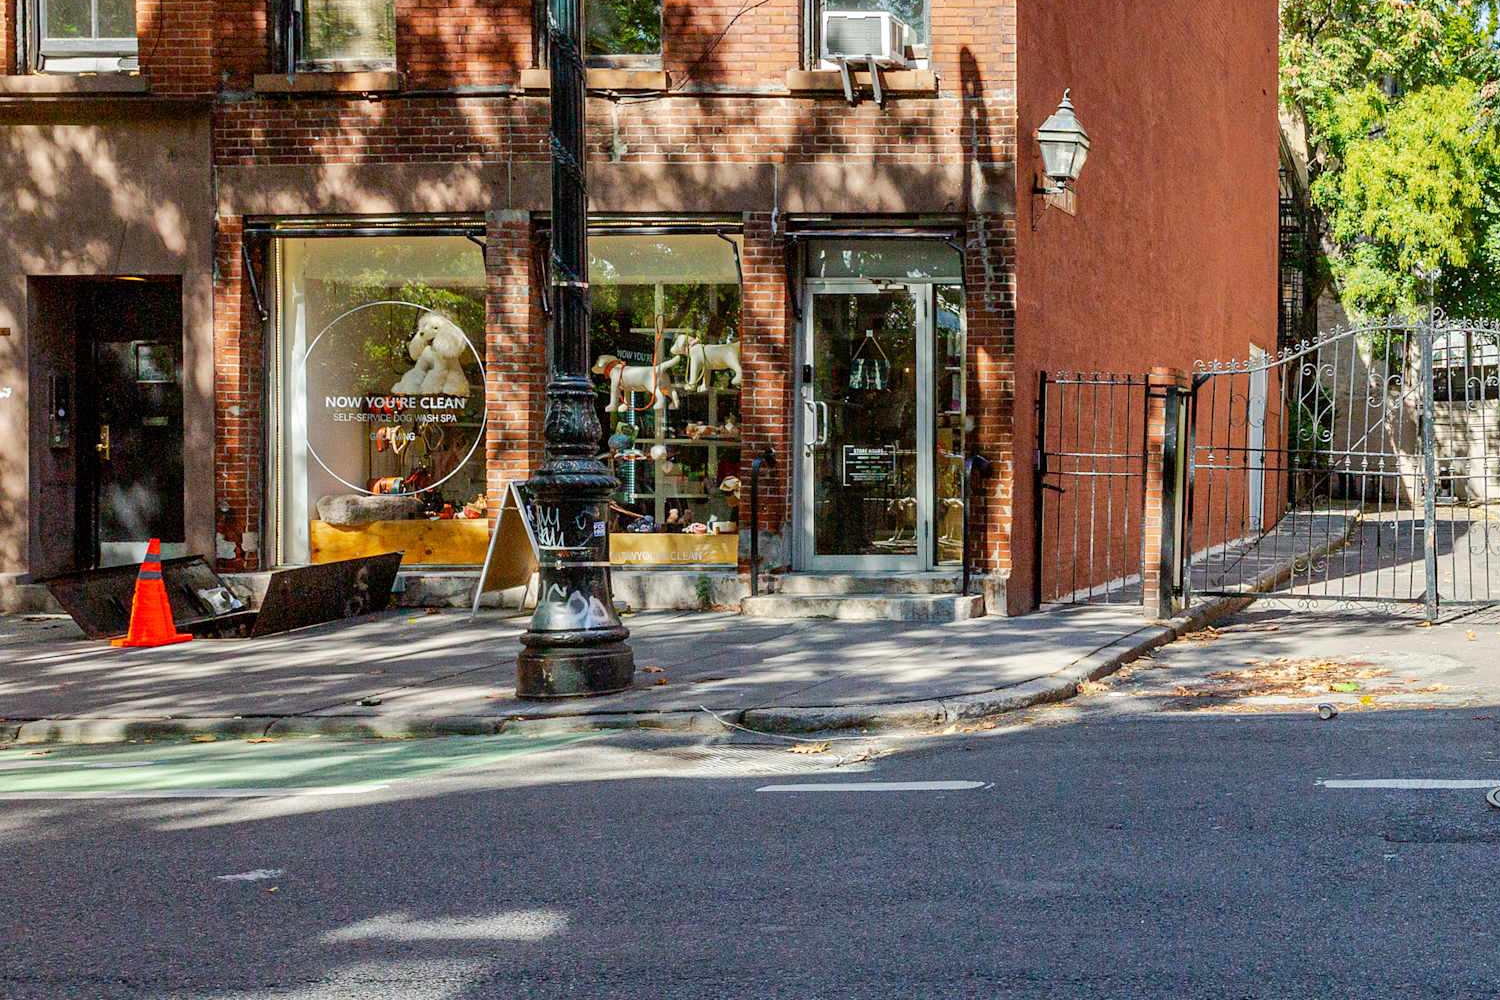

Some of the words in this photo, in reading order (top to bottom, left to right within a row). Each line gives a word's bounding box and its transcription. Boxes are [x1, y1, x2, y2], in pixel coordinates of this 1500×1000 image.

[325, 396, 361, 409] NOW
[364, 396, 416, 409] YOU'RE
[420, 396, 466, 409] CLEAN
[333, 413, 391, 423] SELF-SERVICE
[393, 413, 412, 423] DOG
[415, 413, 439, 423] WASH
[440, 413, 457, 423] SPA
